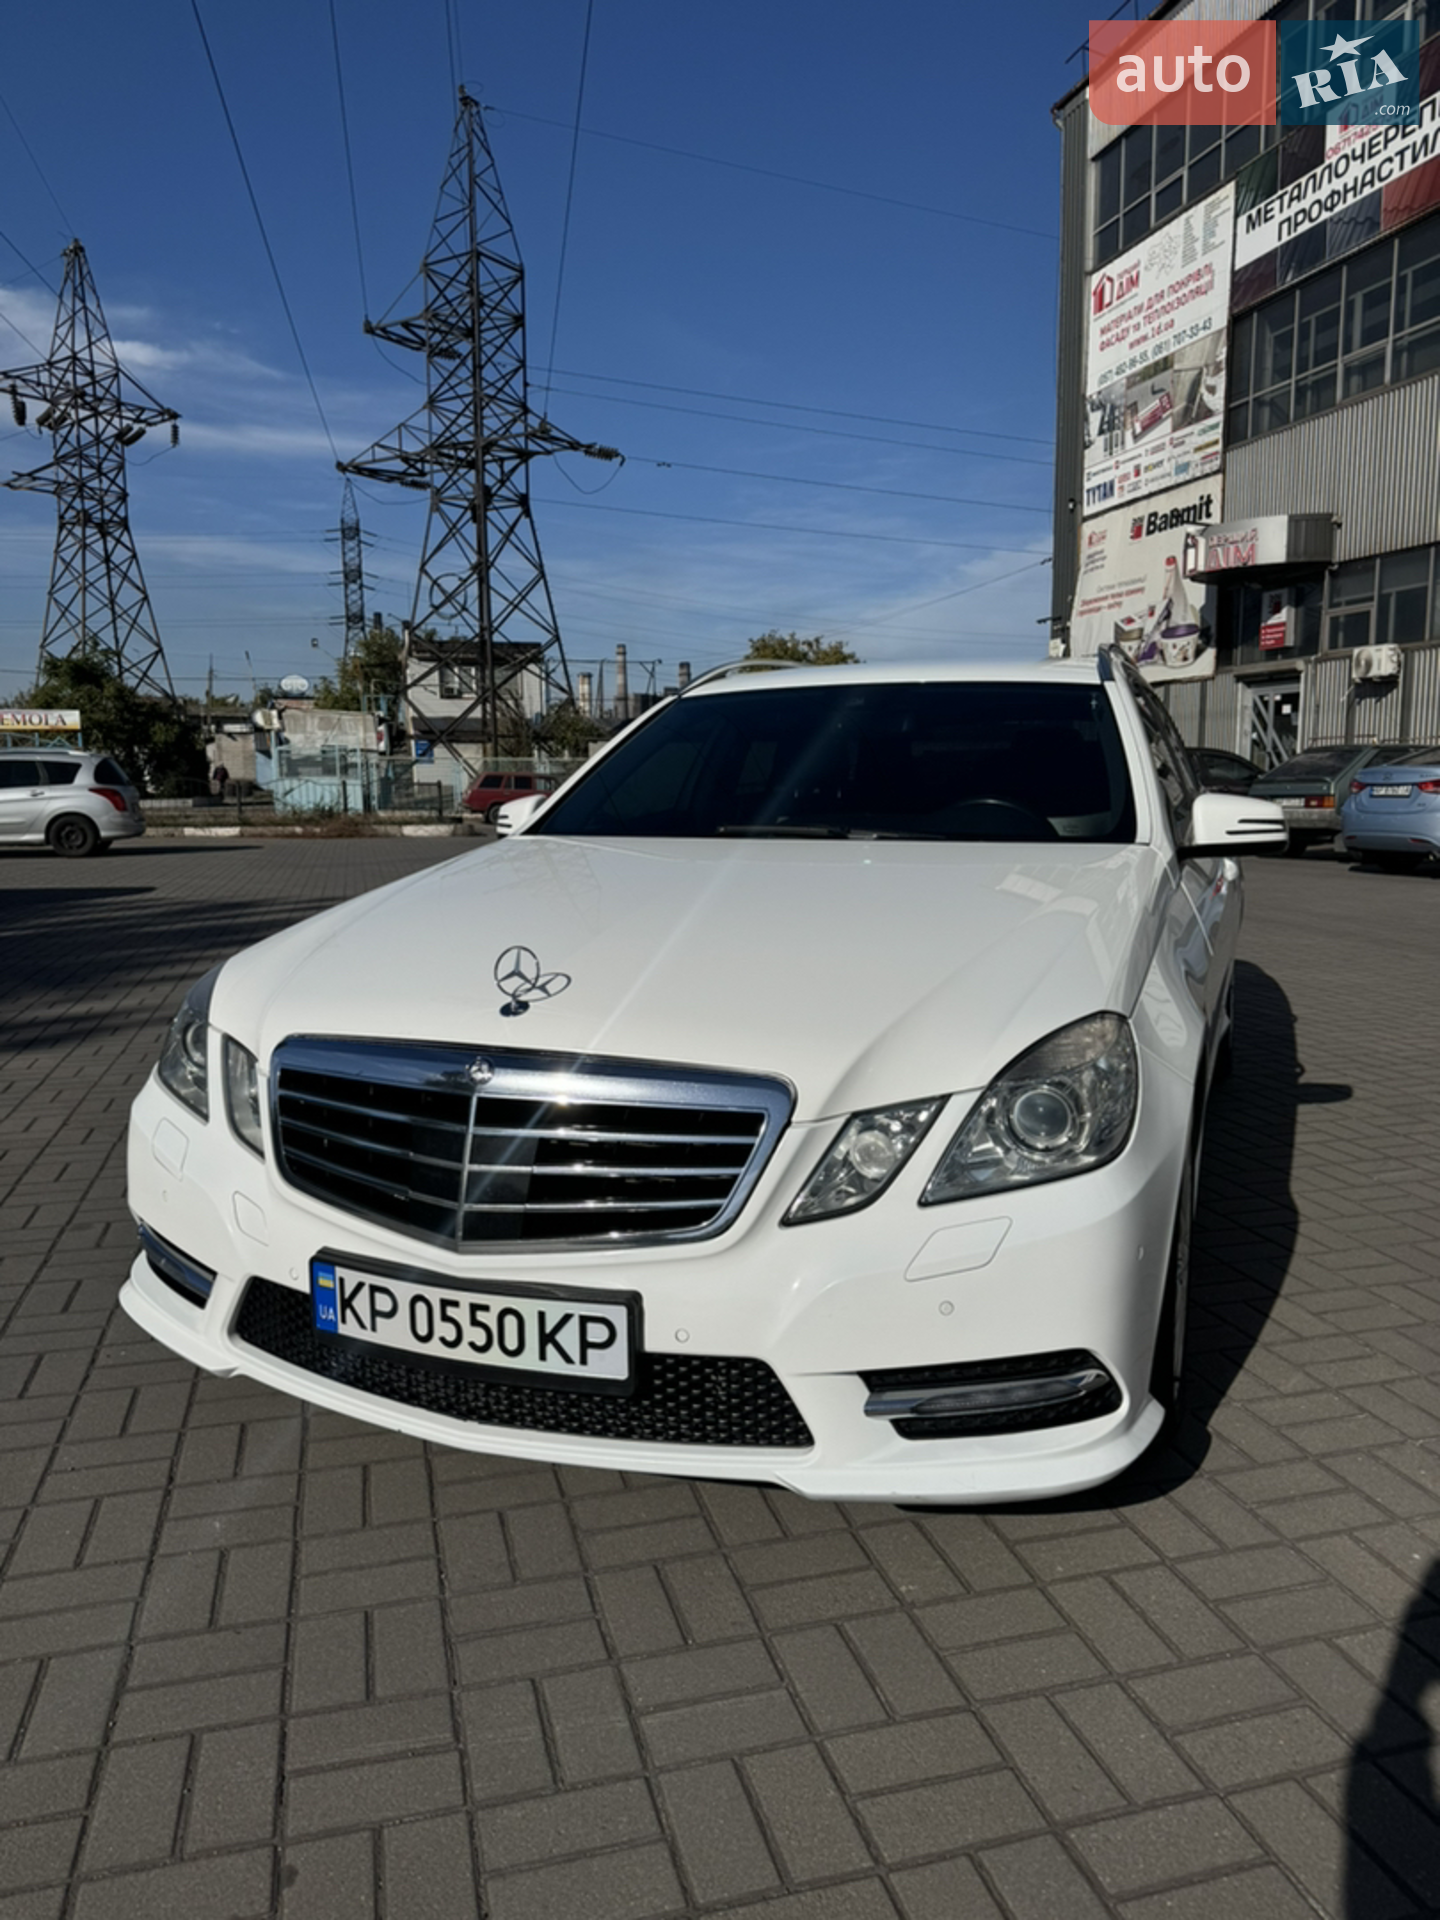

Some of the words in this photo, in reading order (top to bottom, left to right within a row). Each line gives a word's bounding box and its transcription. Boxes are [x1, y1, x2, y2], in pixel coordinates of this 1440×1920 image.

[1246, 96, 1440, 235] МЕТАЛЛОЧЕРЕП
[1086, 481, 1115, 507] TYTAN
[318, 1305, 336, 1322] UA
[338, 1277, 399, 1332] KP
[409, 1294, 525, 1358] 0550
[537, 1310, 617, 1366] KP
